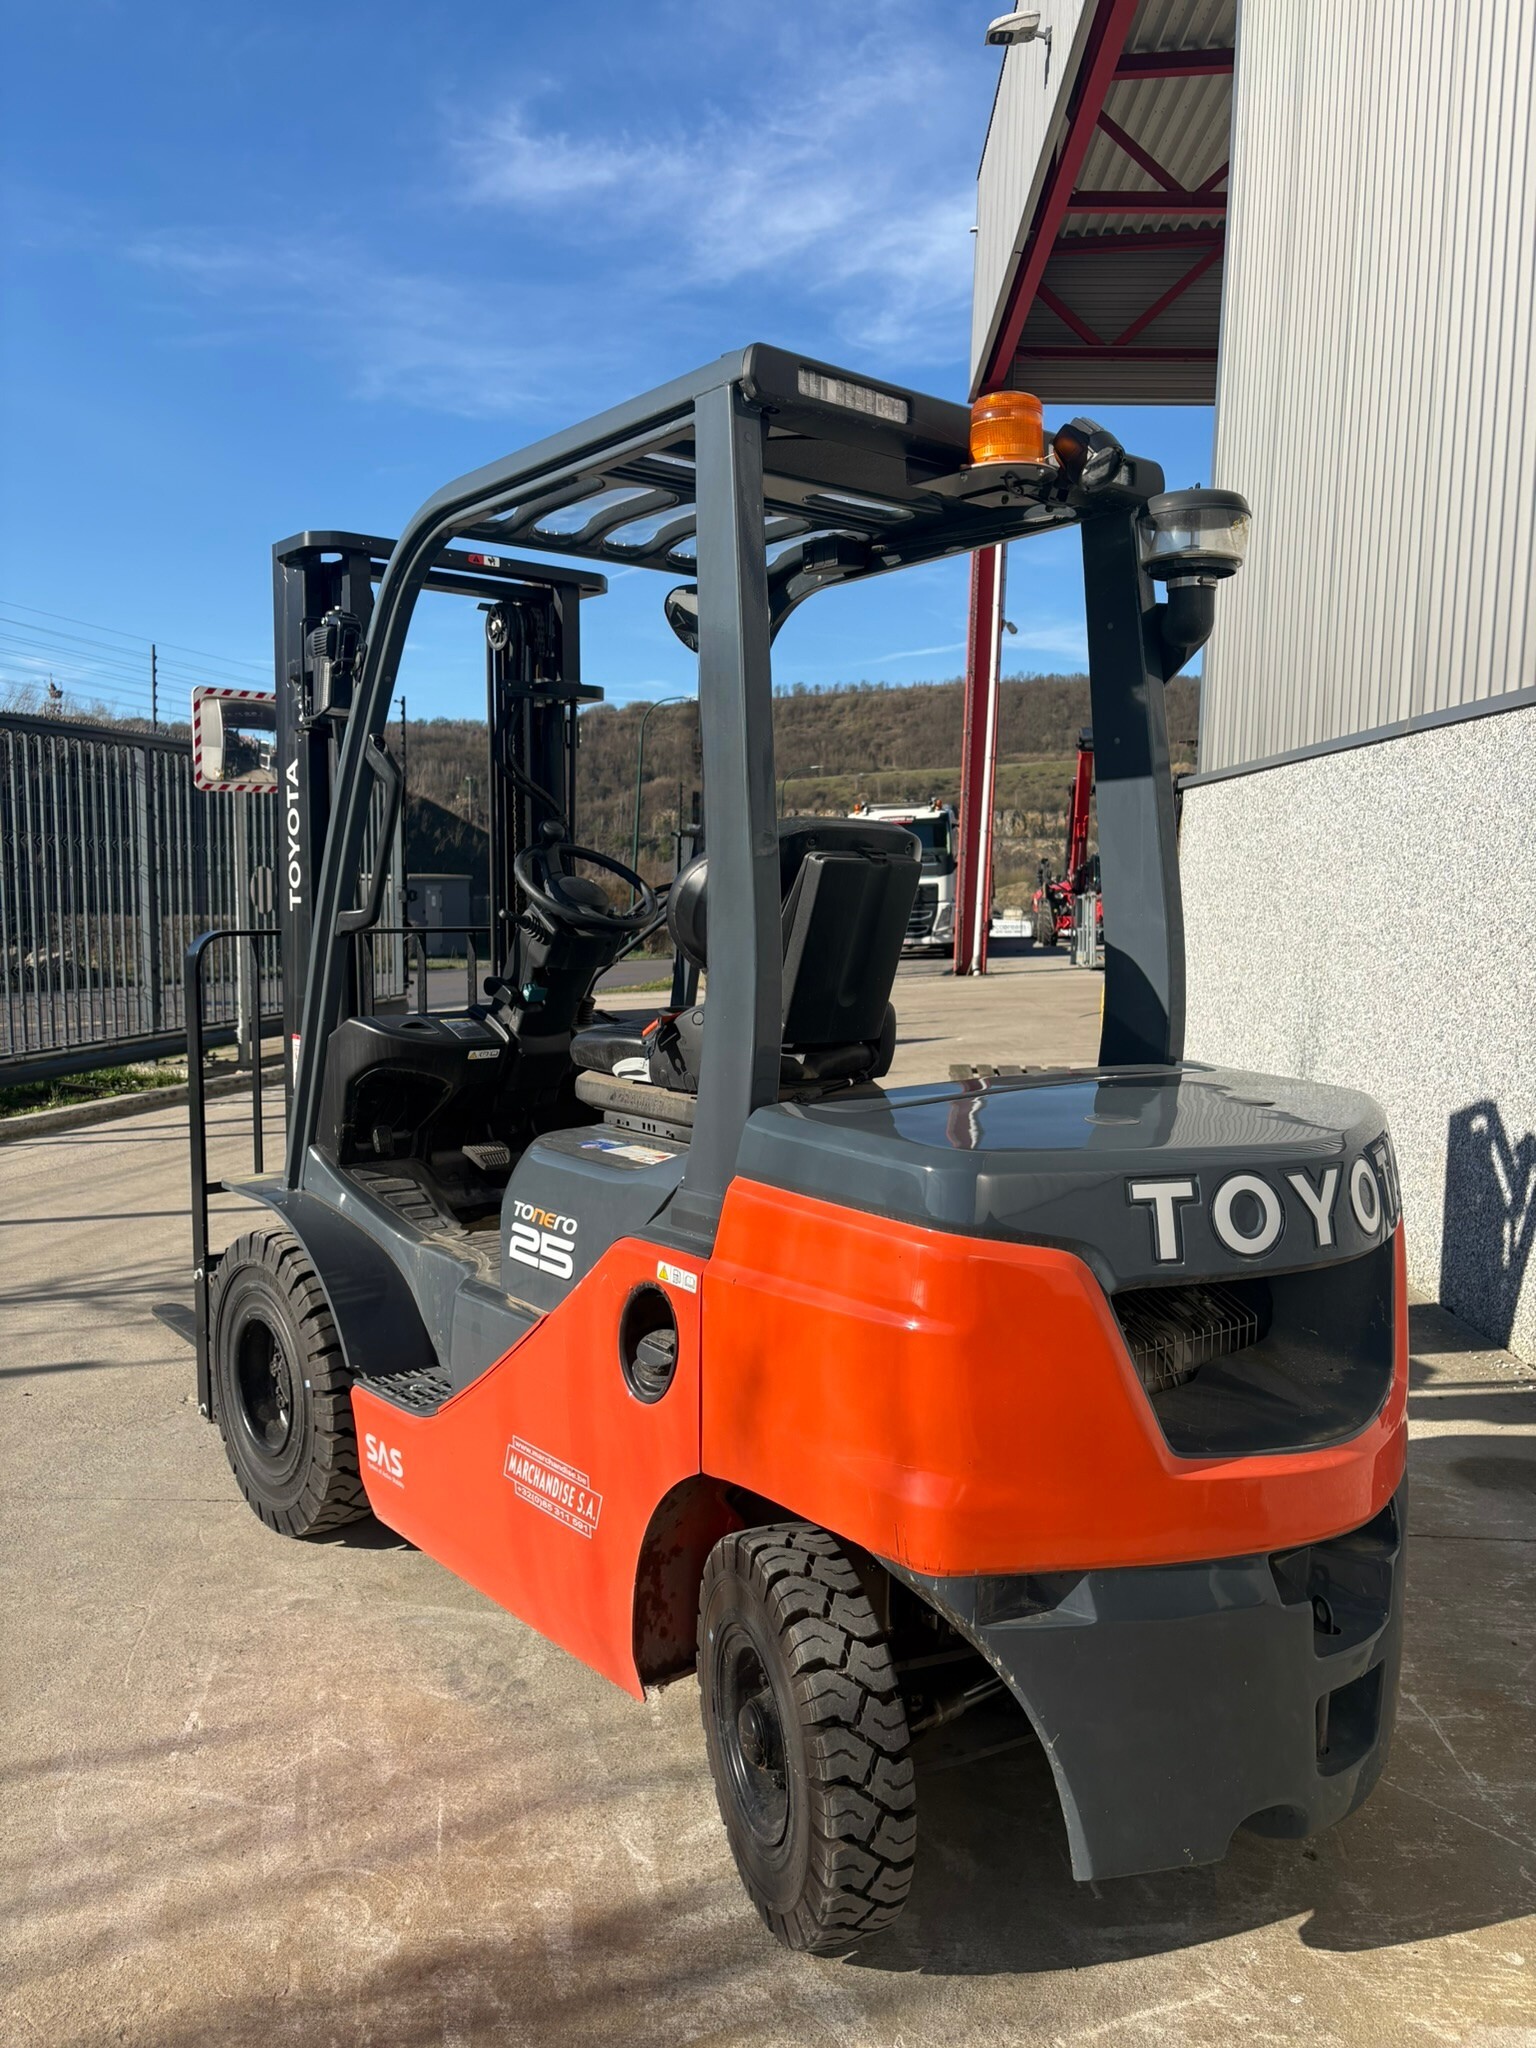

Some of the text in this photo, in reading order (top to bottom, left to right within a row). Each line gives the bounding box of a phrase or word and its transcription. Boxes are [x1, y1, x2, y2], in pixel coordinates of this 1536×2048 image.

[286, 758, 302, 912] TOYOTA
[509, 1222, 575, 1280] 25
[365, 1432, 404, 1478] SAS
[514, 1440, 587, 1485] www.marchandise.be
[508, 1452, 596, 1521] MARCHANDISE S.A.
[554, 1507, 570, 1522] 311
